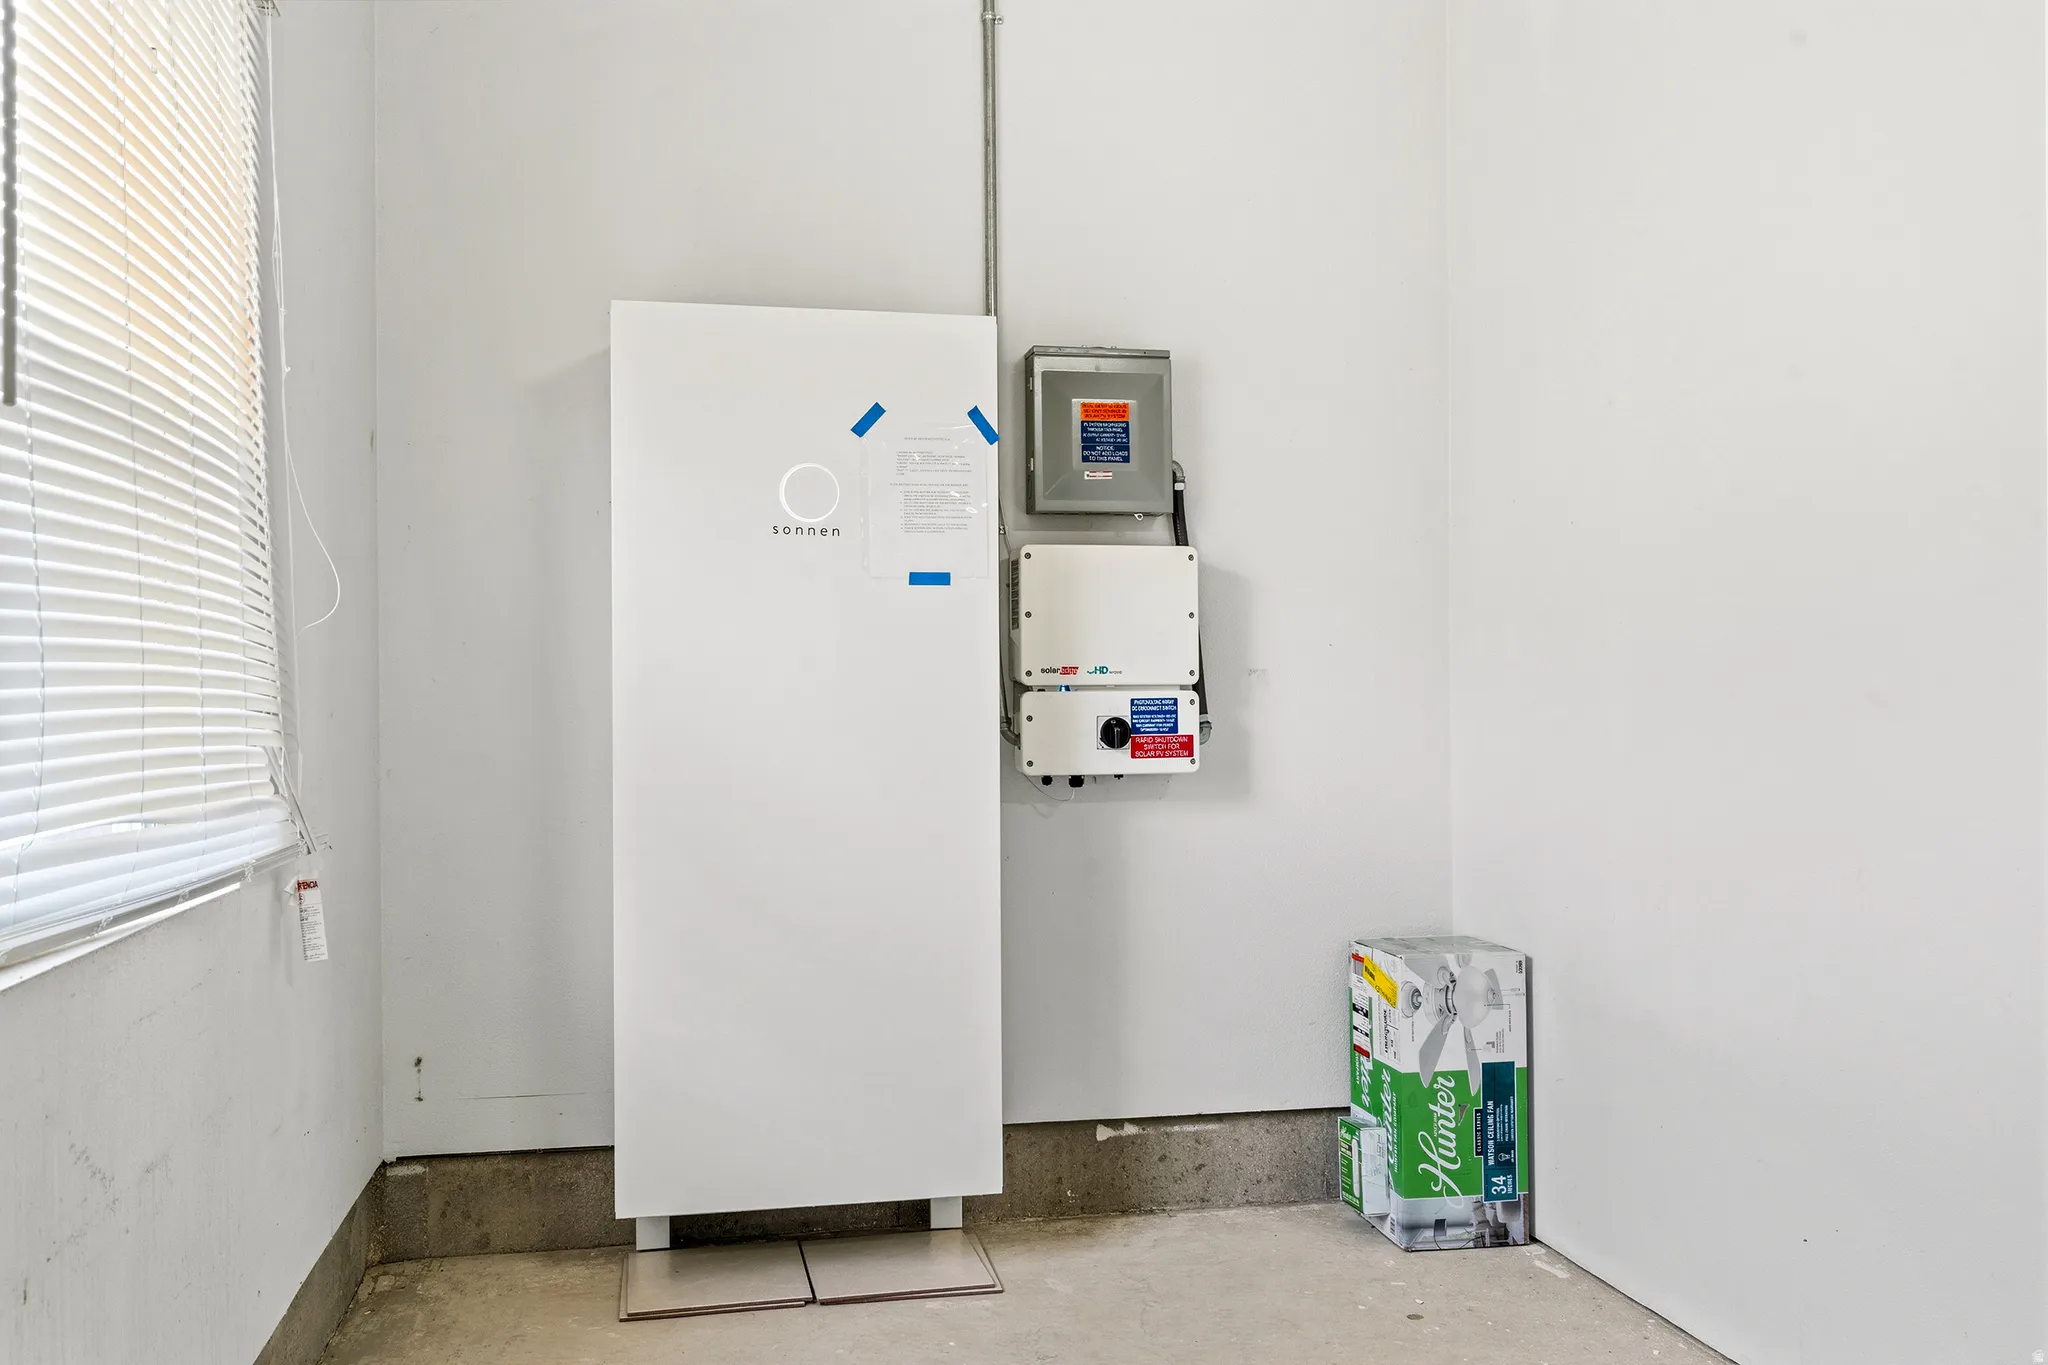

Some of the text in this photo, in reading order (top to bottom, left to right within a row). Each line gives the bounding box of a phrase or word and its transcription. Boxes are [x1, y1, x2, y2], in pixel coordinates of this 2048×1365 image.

[772, 525, 840, 537] sonnen
[1418, 1075, 1464, 1209] Hunter
[1490, 1176, 1507, 1195] 34
